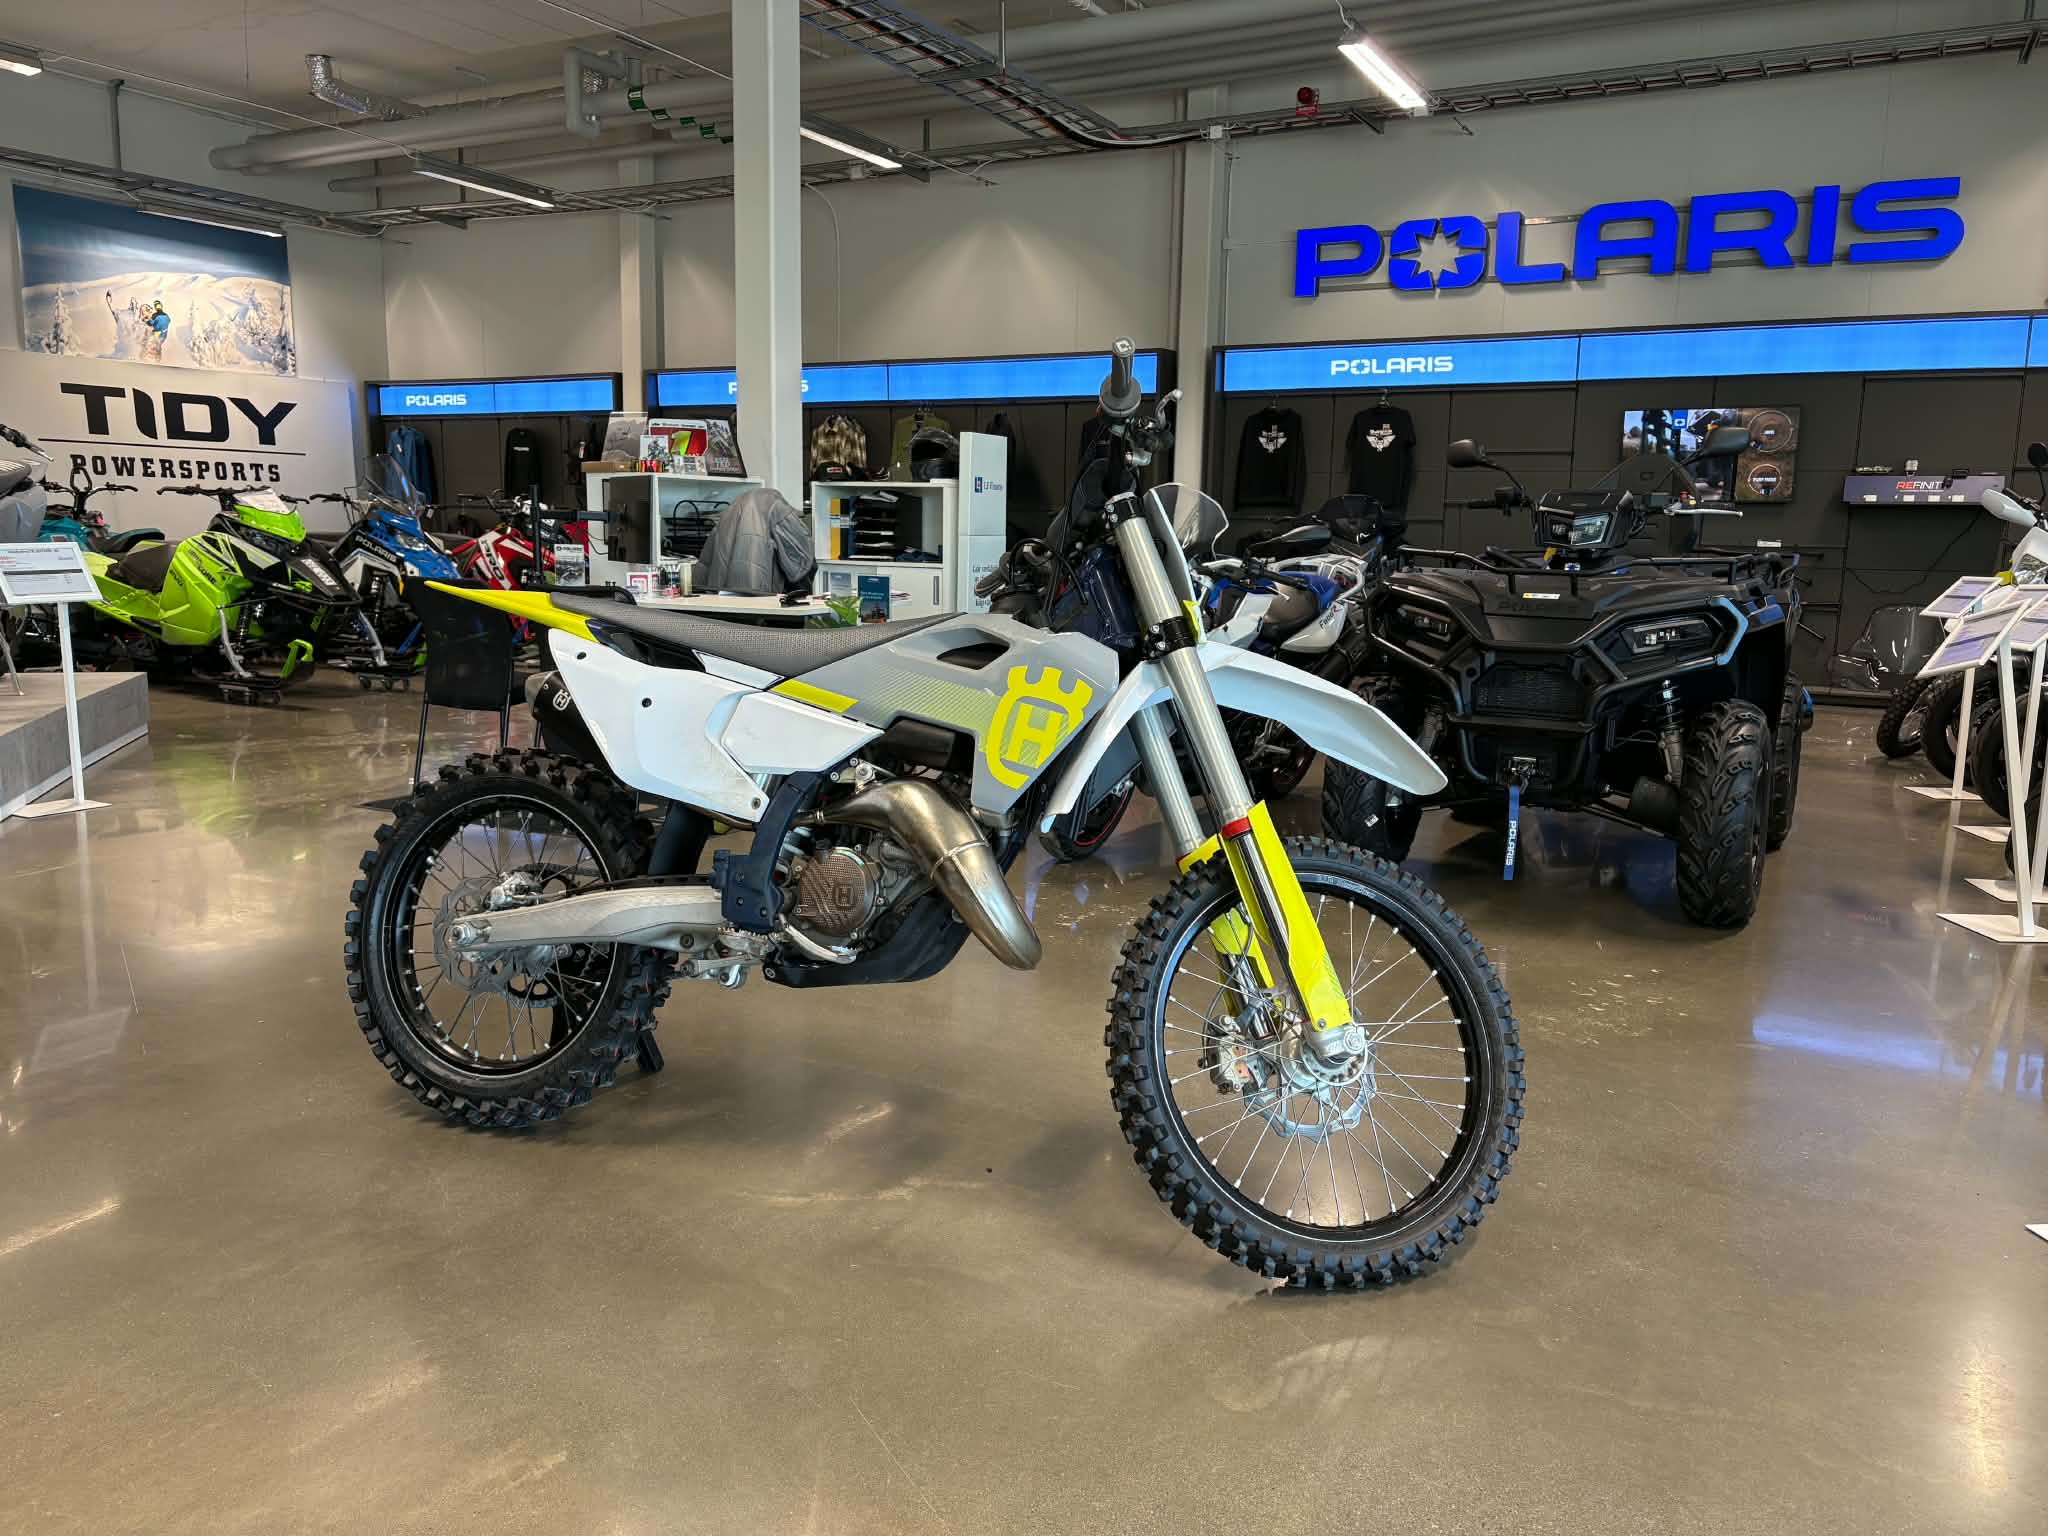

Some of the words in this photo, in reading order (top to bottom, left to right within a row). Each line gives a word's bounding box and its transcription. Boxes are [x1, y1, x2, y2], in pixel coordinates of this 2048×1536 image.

[1294, 177, 1966, 298] POLARIS
[1330, 355, 1454, 376] POLARIS
[60, 382, 297, 446] TIDY
[405, 394, 467, 407] POLARIS
[70, 454, 281, 483] POWERSPORTS
[355, 535, 398, 562] POLARIS
[1505, 820, 1517, 866] POLARIS
